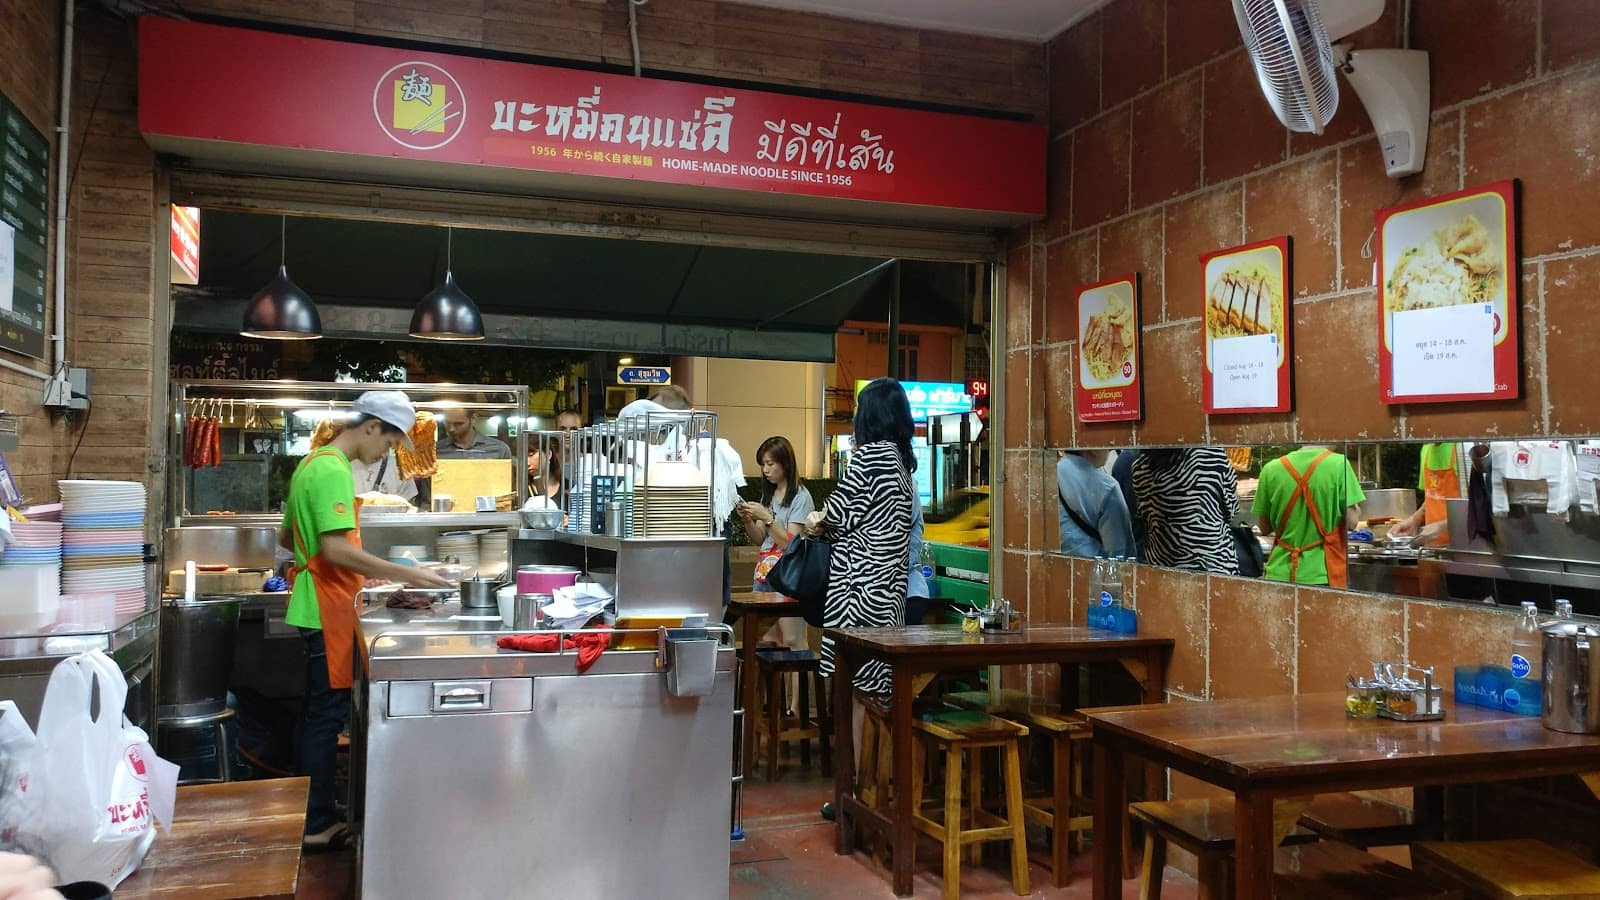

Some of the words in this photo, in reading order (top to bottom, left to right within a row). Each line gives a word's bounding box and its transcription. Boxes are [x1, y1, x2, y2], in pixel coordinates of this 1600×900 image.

[531, 145, 557, 157] 1956
[756, 112, 895, 174] มีดีที่เส้น
[662, 157, 738, 175] HOME-MADE
[740, 165, 789, 180] NOODLE
[790, 170, 824, 184] SINCE
[825, 173, 853, 186] 1956
[972, 381, 987, 396] 94
